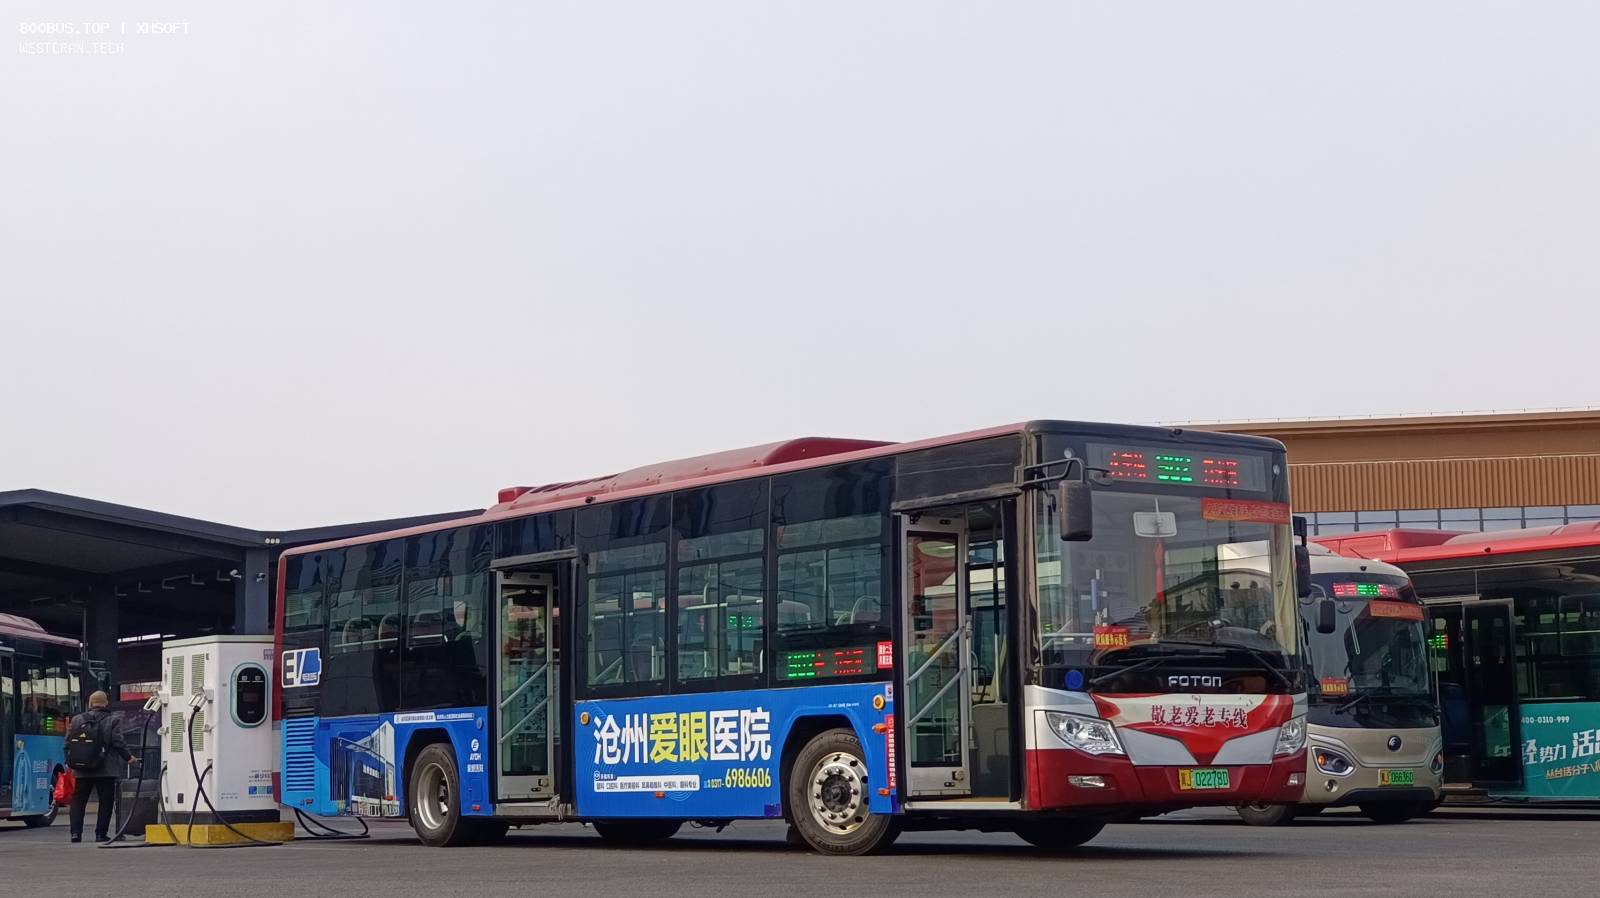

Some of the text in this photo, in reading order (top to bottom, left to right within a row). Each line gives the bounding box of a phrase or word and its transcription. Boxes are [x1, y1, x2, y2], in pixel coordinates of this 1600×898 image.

[1168, 675, 1222, 687] FOTON
[1151, 704, 1249, 729] 敬老爱老专线
[593, 707, 772, 765] 沧州爱眼医院
[1195, 770, 1229, 787] 02278D
